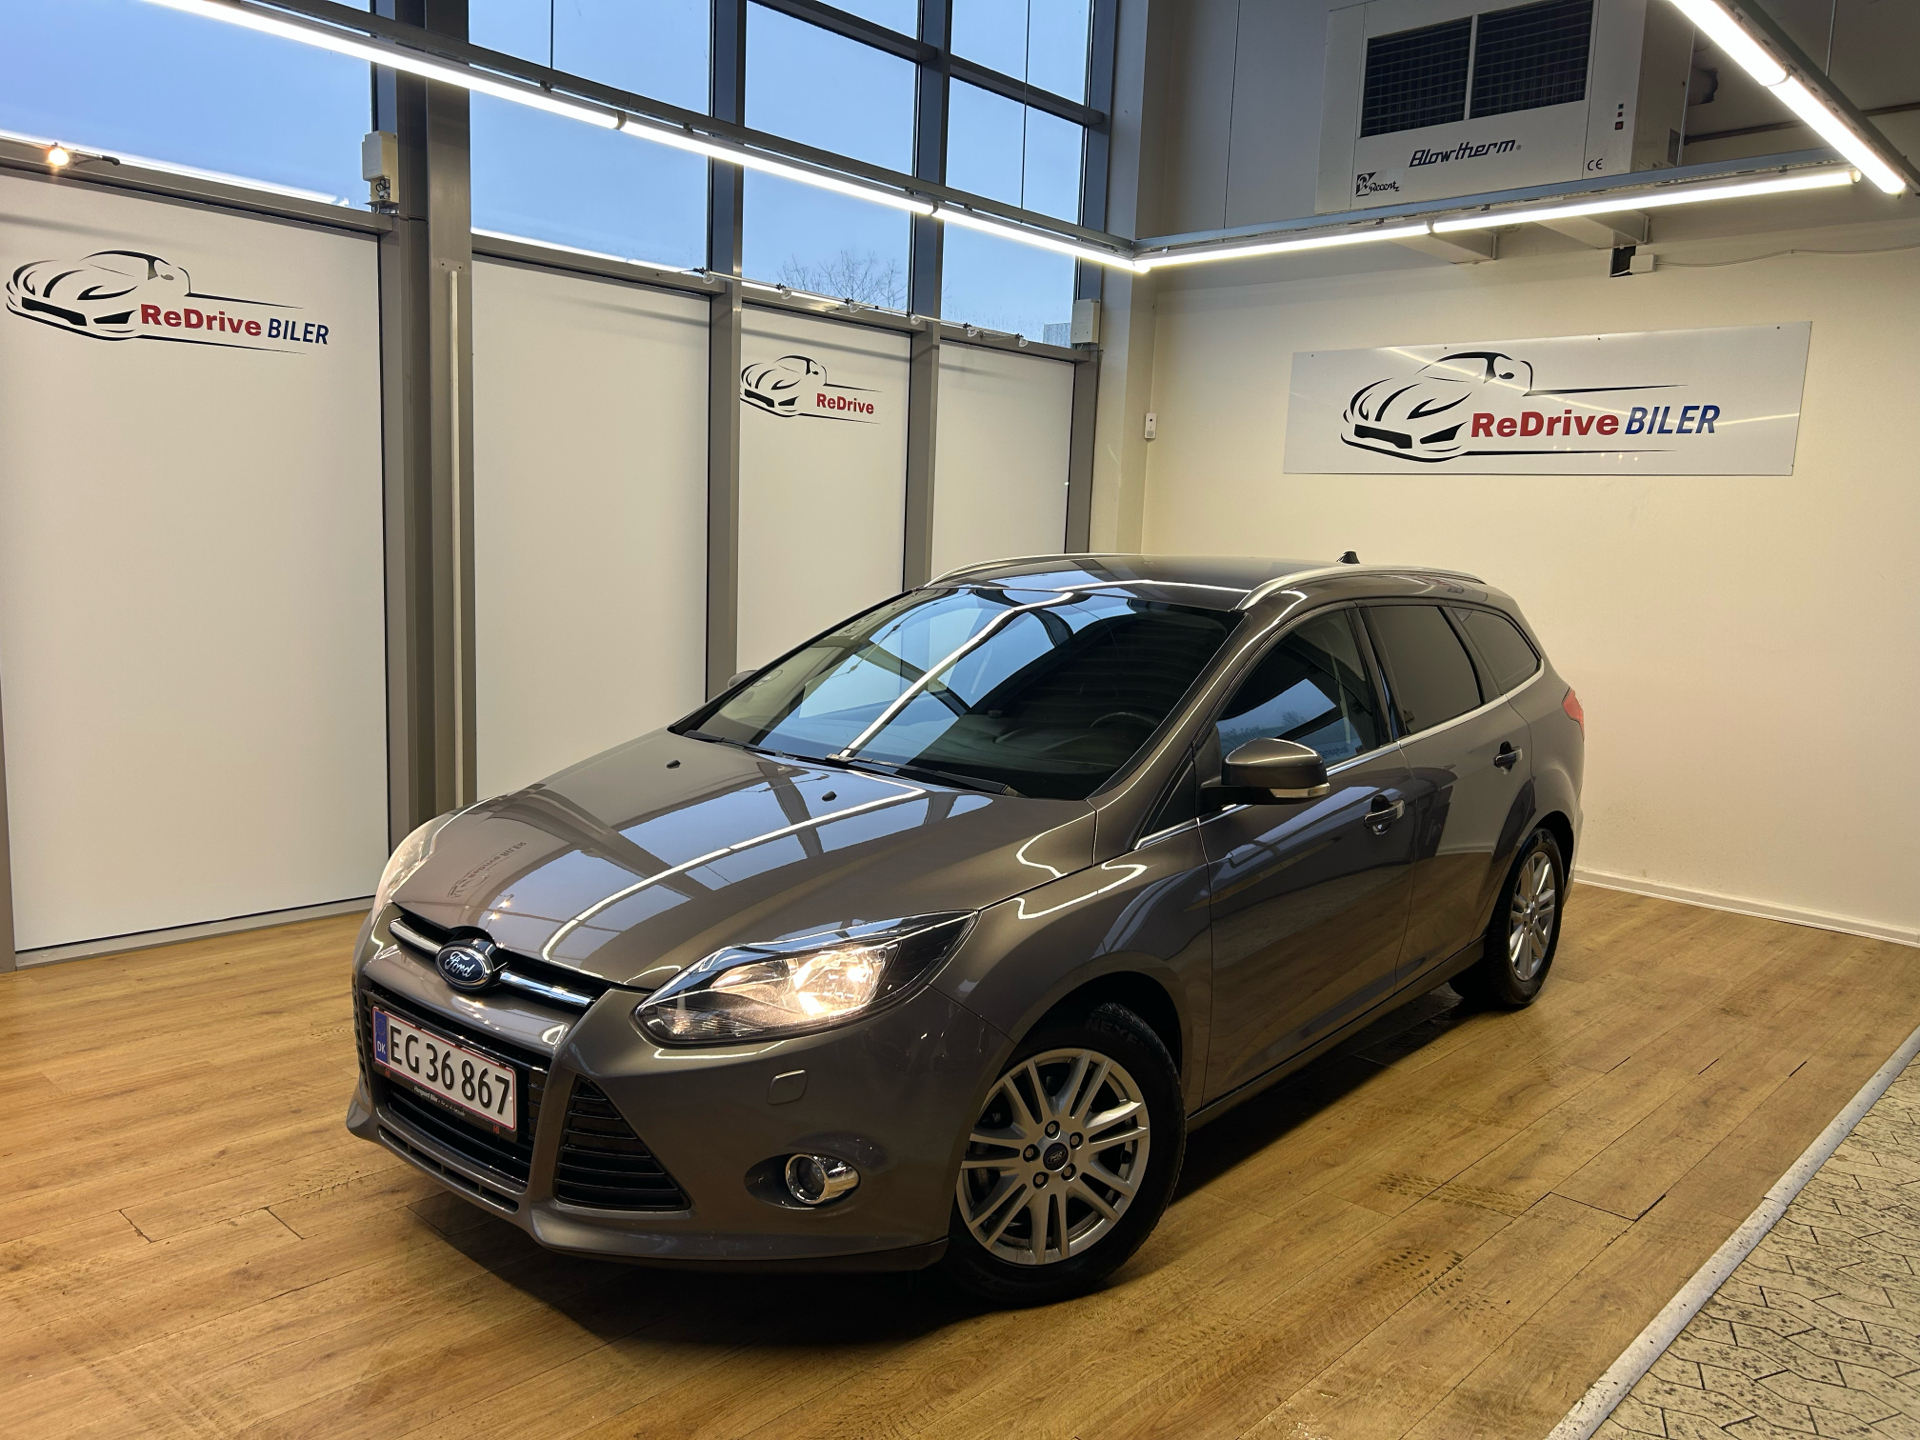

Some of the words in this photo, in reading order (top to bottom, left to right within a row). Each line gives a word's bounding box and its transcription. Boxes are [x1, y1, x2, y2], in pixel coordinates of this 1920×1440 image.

[1409, 139, 1516, 168] Blowtherm
[140, 303, 262, 337] ReDrive
[267, 318, 330, 346] BILER
[816, 392, 875, 415] ReDrive
[1470, 409, 1619, 438] ReDrive
[1625, 404, 1721, 435] BILER
[444, 951, 475, 979] Ford
[376, 1041, 386, 1055] DK
[390, 1025, 420, 1074] EG
[426, 1040, 455, 1091] 36
[461, 1059, 510, 1115] 867
